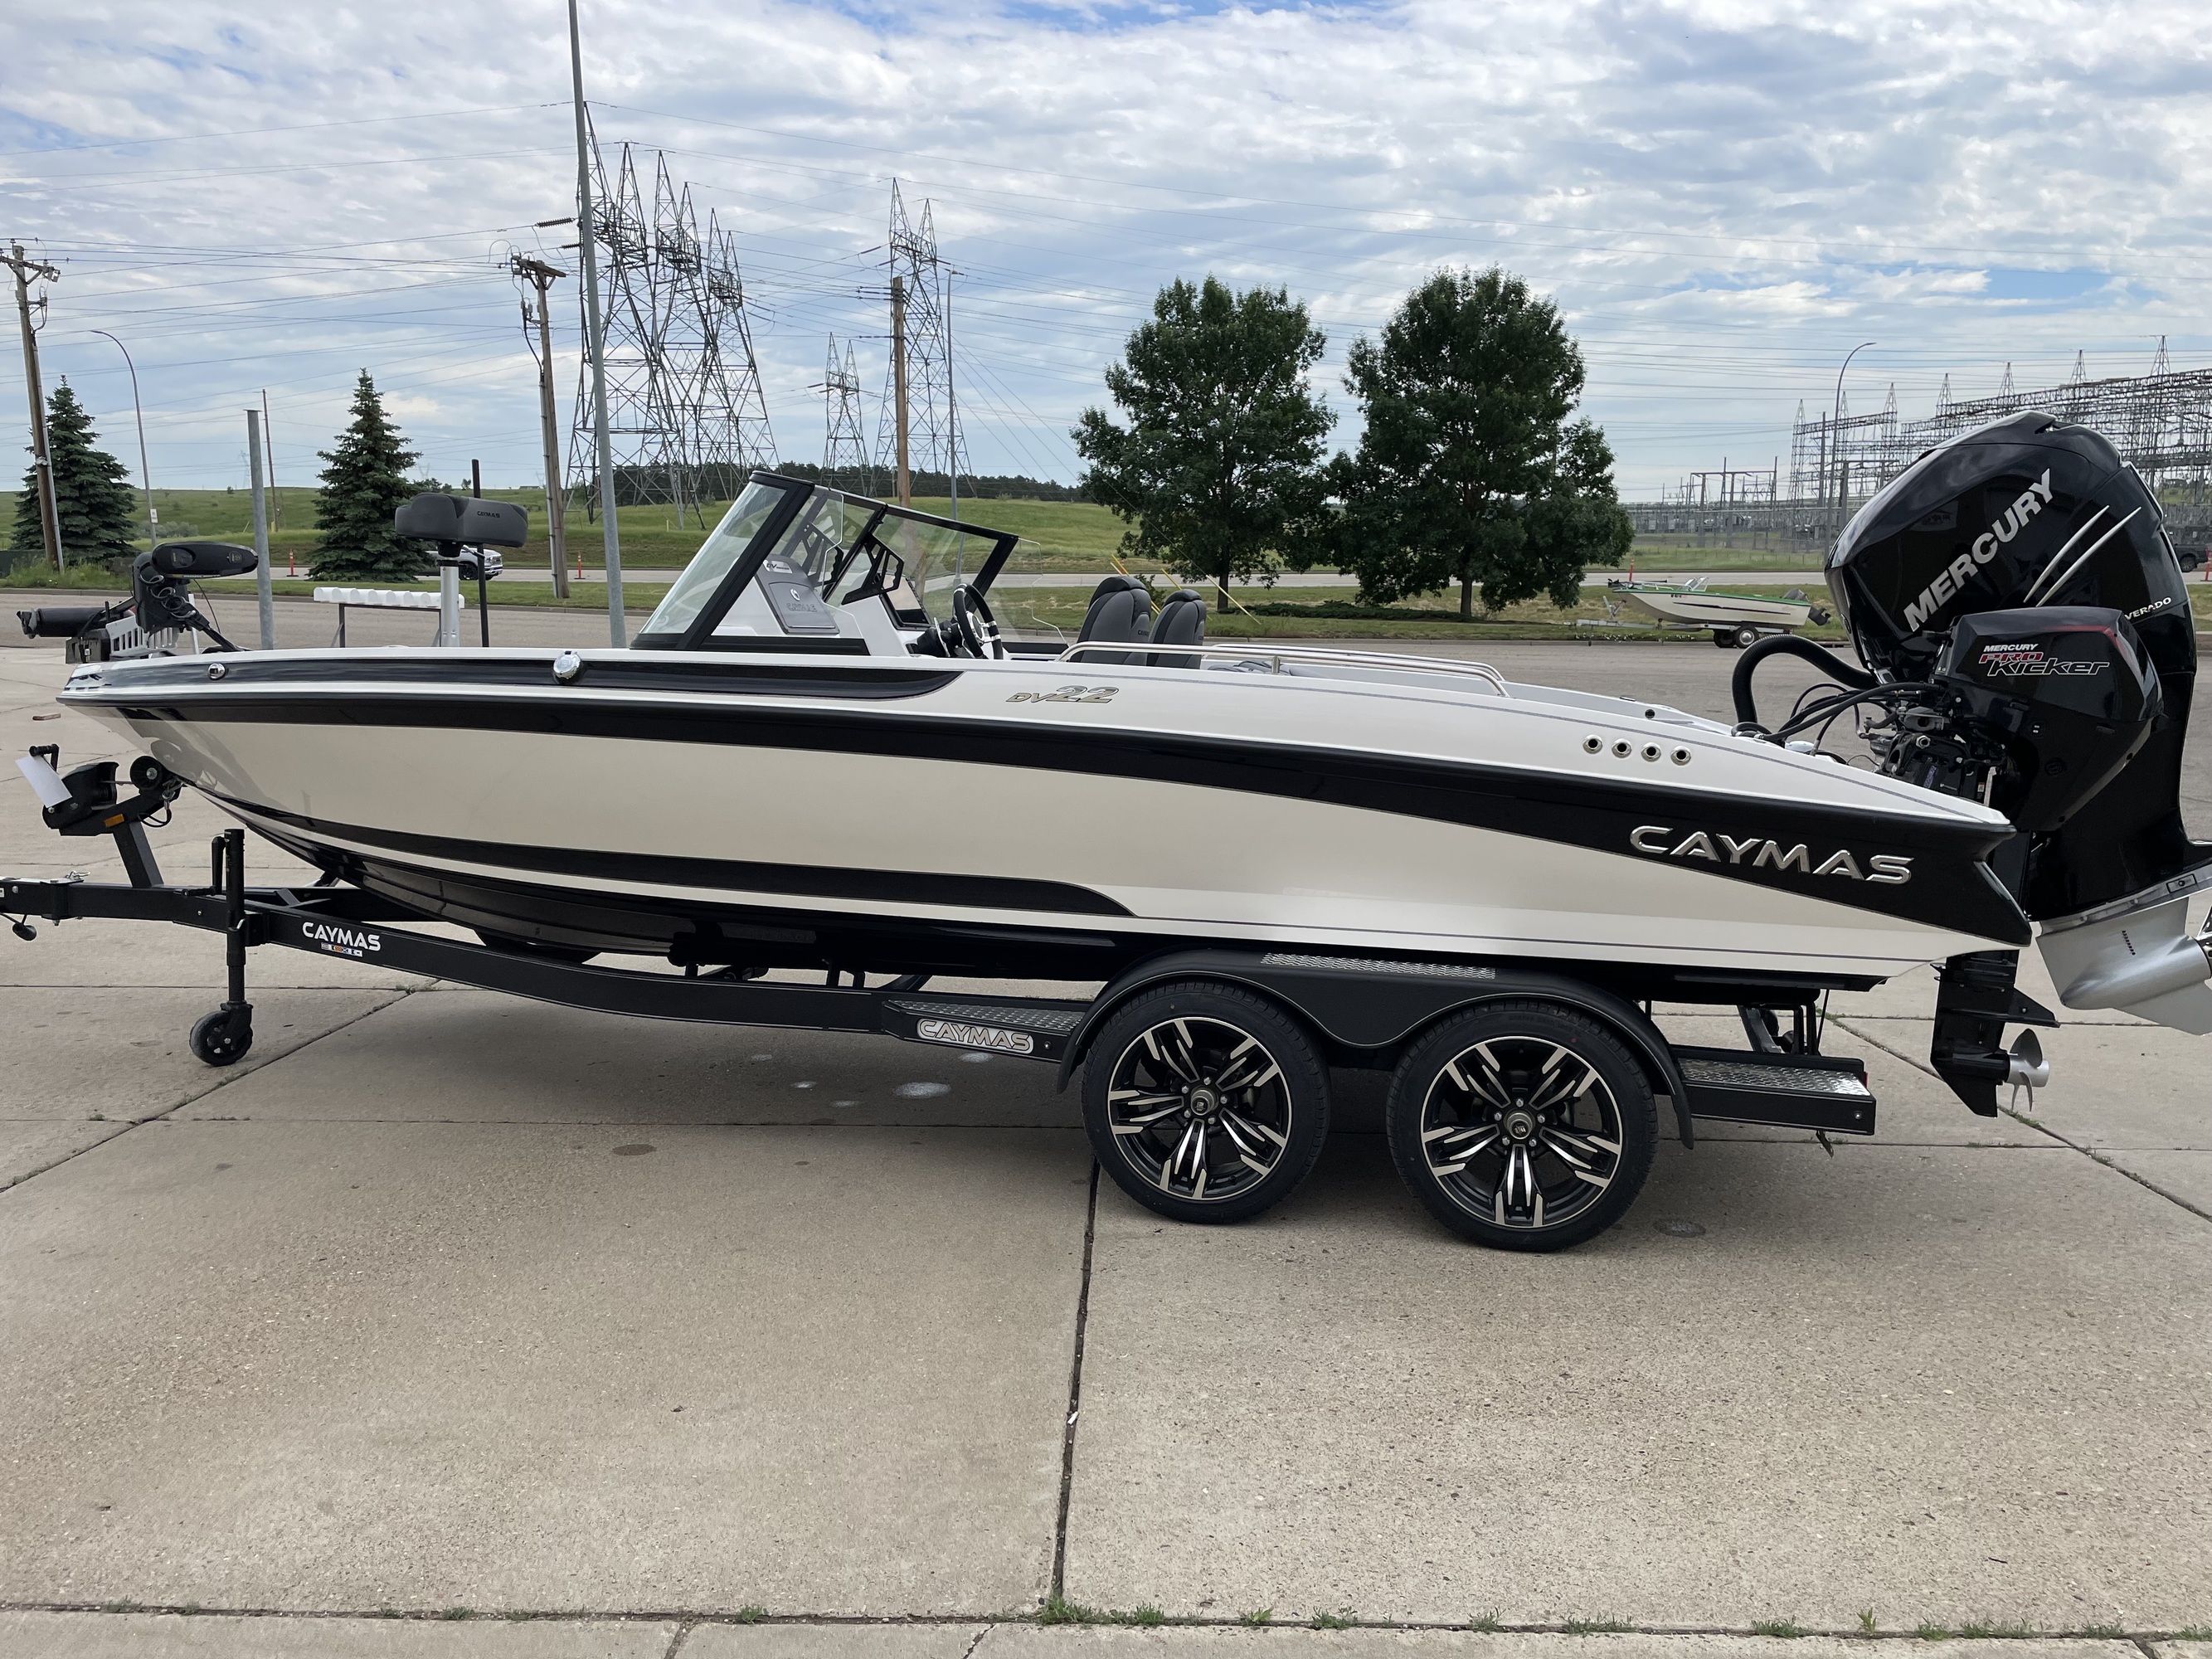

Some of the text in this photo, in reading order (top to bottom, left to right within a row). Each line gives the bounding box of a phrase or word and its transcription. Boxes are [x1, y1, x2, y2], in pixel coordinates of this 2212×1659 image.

[1903, 468, 2054, 632] MERCURY
[2124, 597, 2171, 620] VERADO
[1979, 652, 2044, 664] PRO
[1983, 644, 2039, 652] MERCURY
[1987, 658, 2110, 677] Kicker
[1005, 685, 1120, 703] DV22
[1630, 825, 1915, 885] CAYMAS
[302, 922, 382, 951] CAYMAS
[919, 1019, 1031, 1051] CAYMAS
